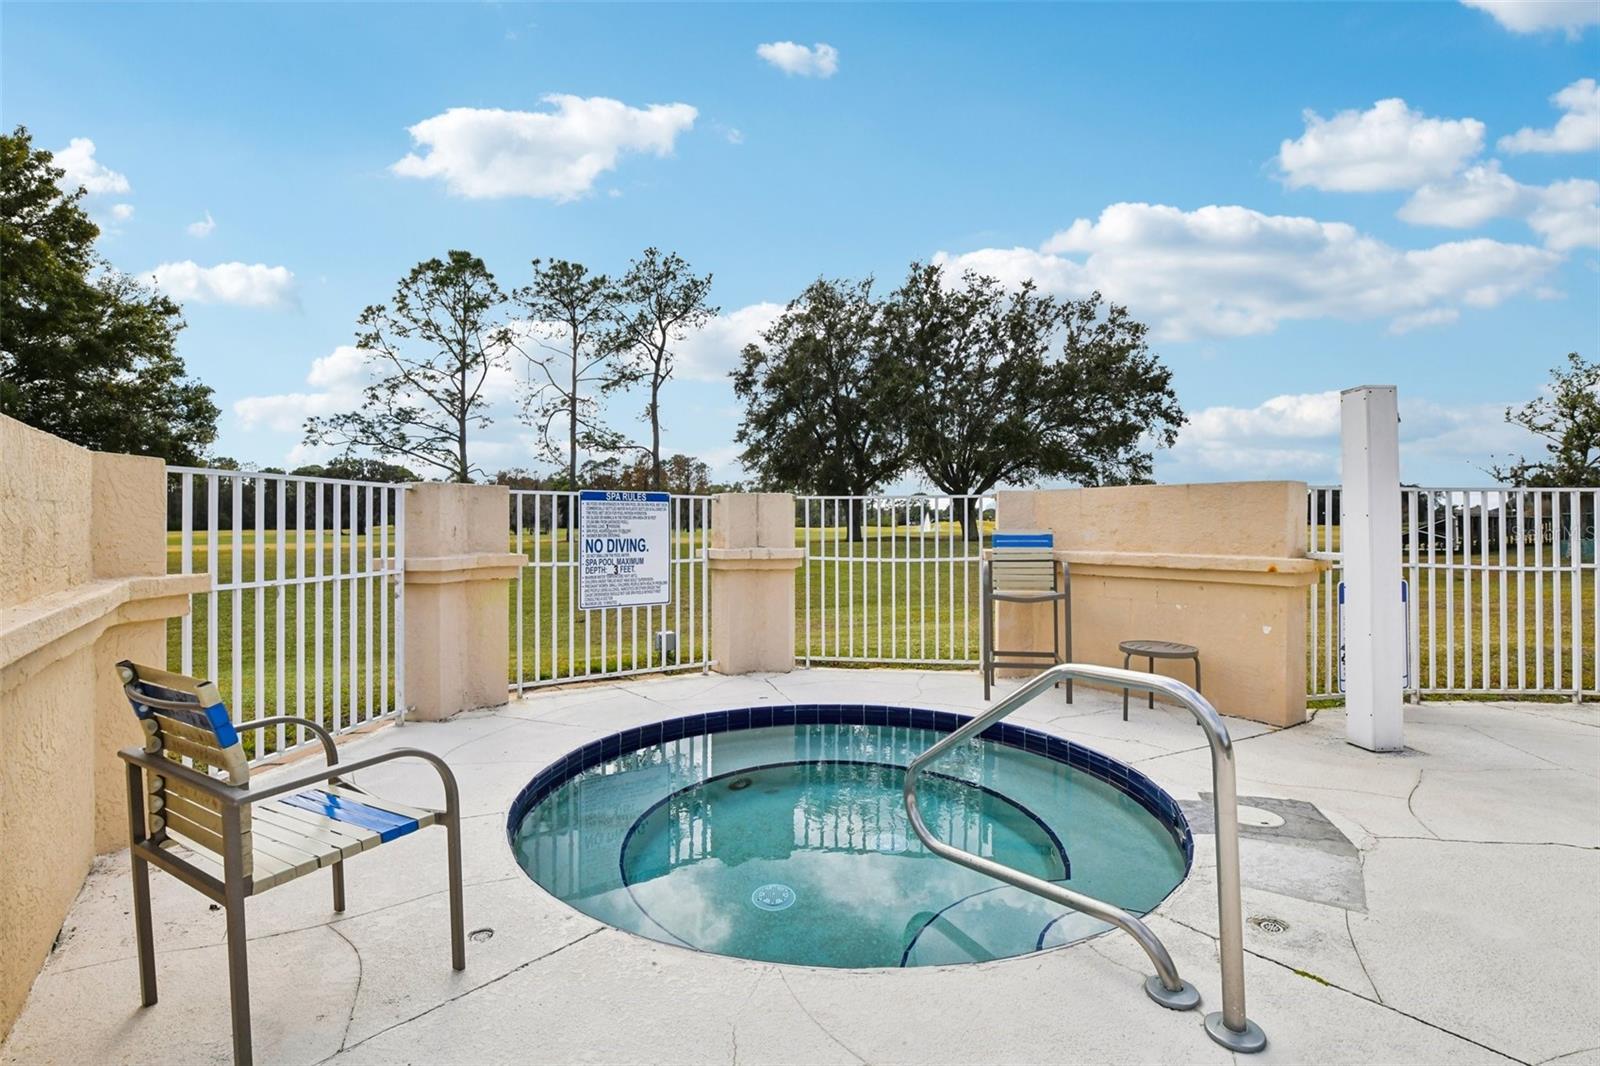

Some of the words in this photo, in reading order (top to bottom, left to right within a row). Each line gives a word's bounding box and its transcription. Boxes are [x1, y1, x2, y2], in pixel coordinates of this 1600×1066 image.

[606, 492, 621, 501] SPA
[622, 493, 647, 501] RULES
[586, 538, 603, 553] NO
[606, 538, 649, 552] DIVING.
[585, 559, 597, 567] SPA
[598, 558, 615, 566] POOL
[616, 557, 644, 565] MAXIMUM
[585, 566, 607, 575] DEPTH:
[613, 565, 619, 575] 3
